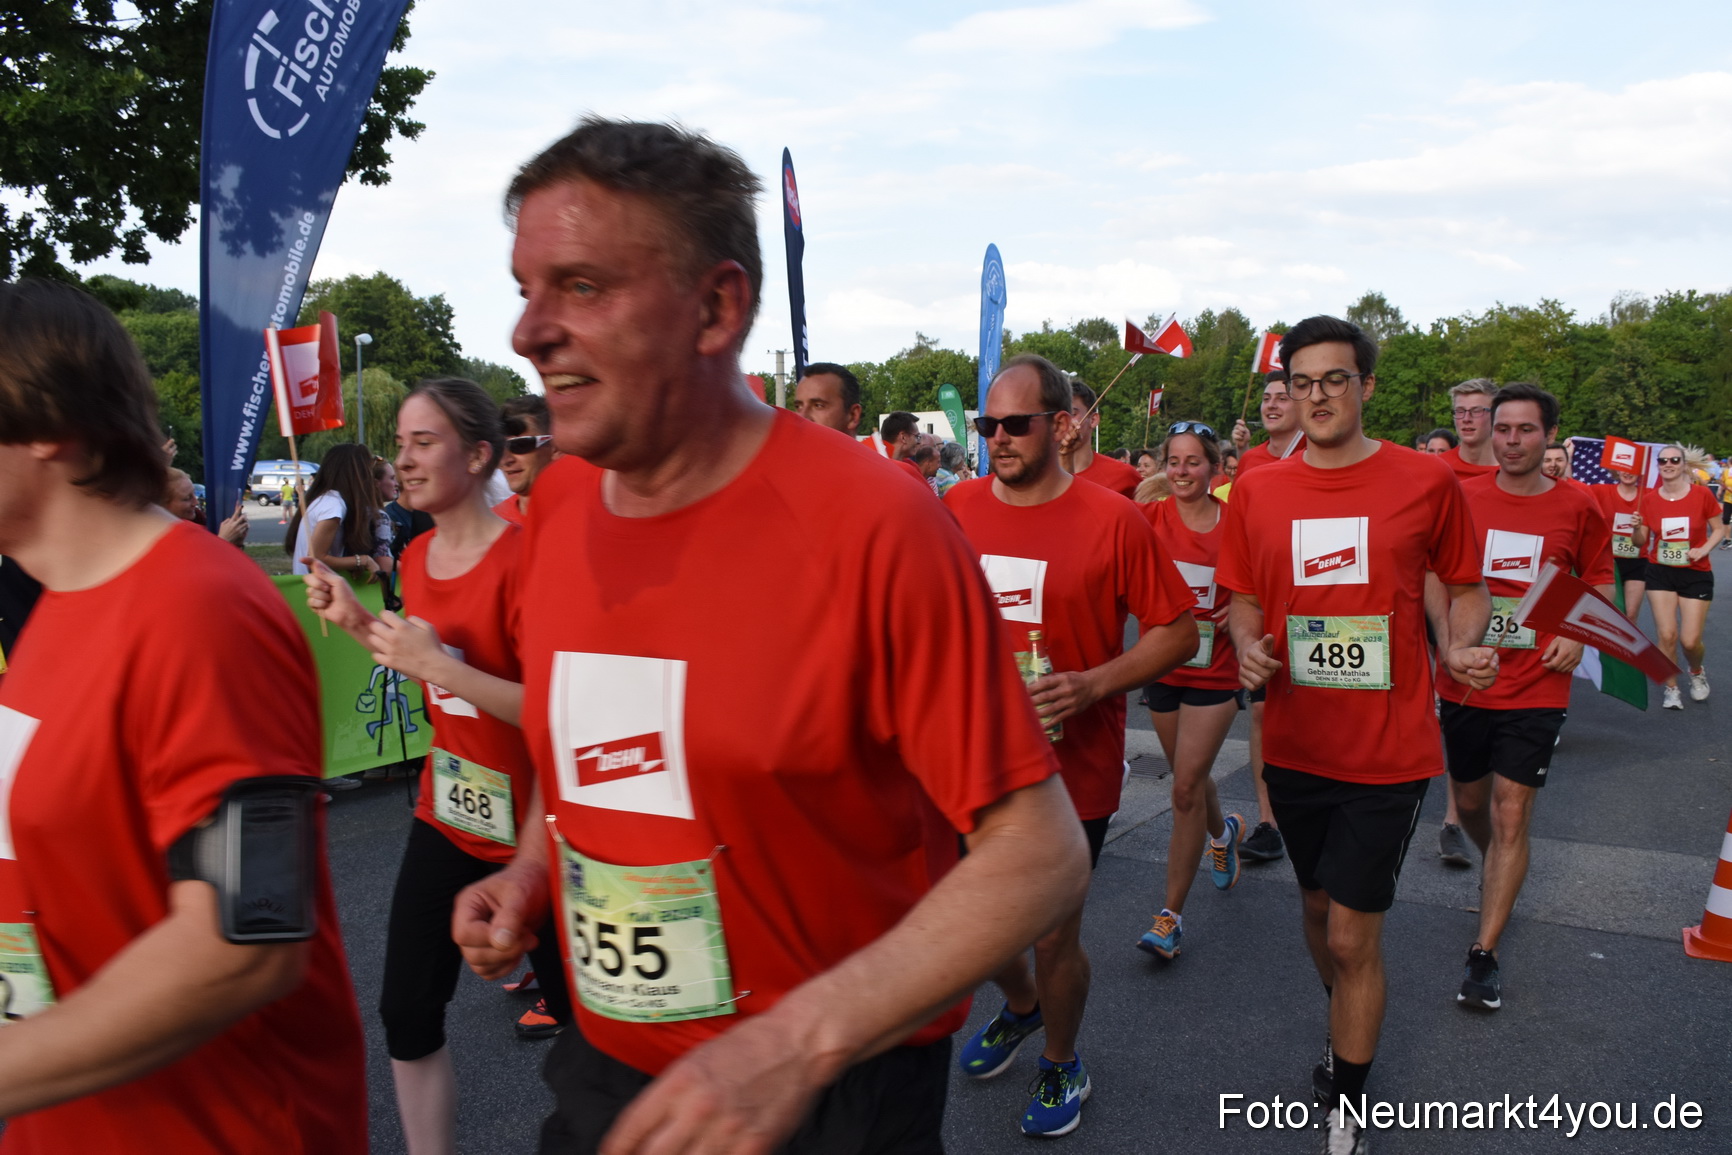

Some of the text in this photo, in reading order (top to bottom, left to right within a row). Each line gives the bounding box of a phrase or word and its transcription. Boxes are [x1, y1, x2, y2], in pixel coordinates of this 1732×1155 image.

[1617, 543, 1635, 553] 556
[1662, 549, 1682, 560] 538
[1318, 556, 1341, 569] DEHN
[1501, 560, 1521, 568] DEHN
[997, 594, 1021, 604] DEHN
[1308, 642, 1365, 669] 489
[1307, 668, 1370, 677] Gebhard Mathias
[596, 746, 646, 772] DEHN
[448, 783, 493, 820] 468
[573, 911, 669, 980] 555
